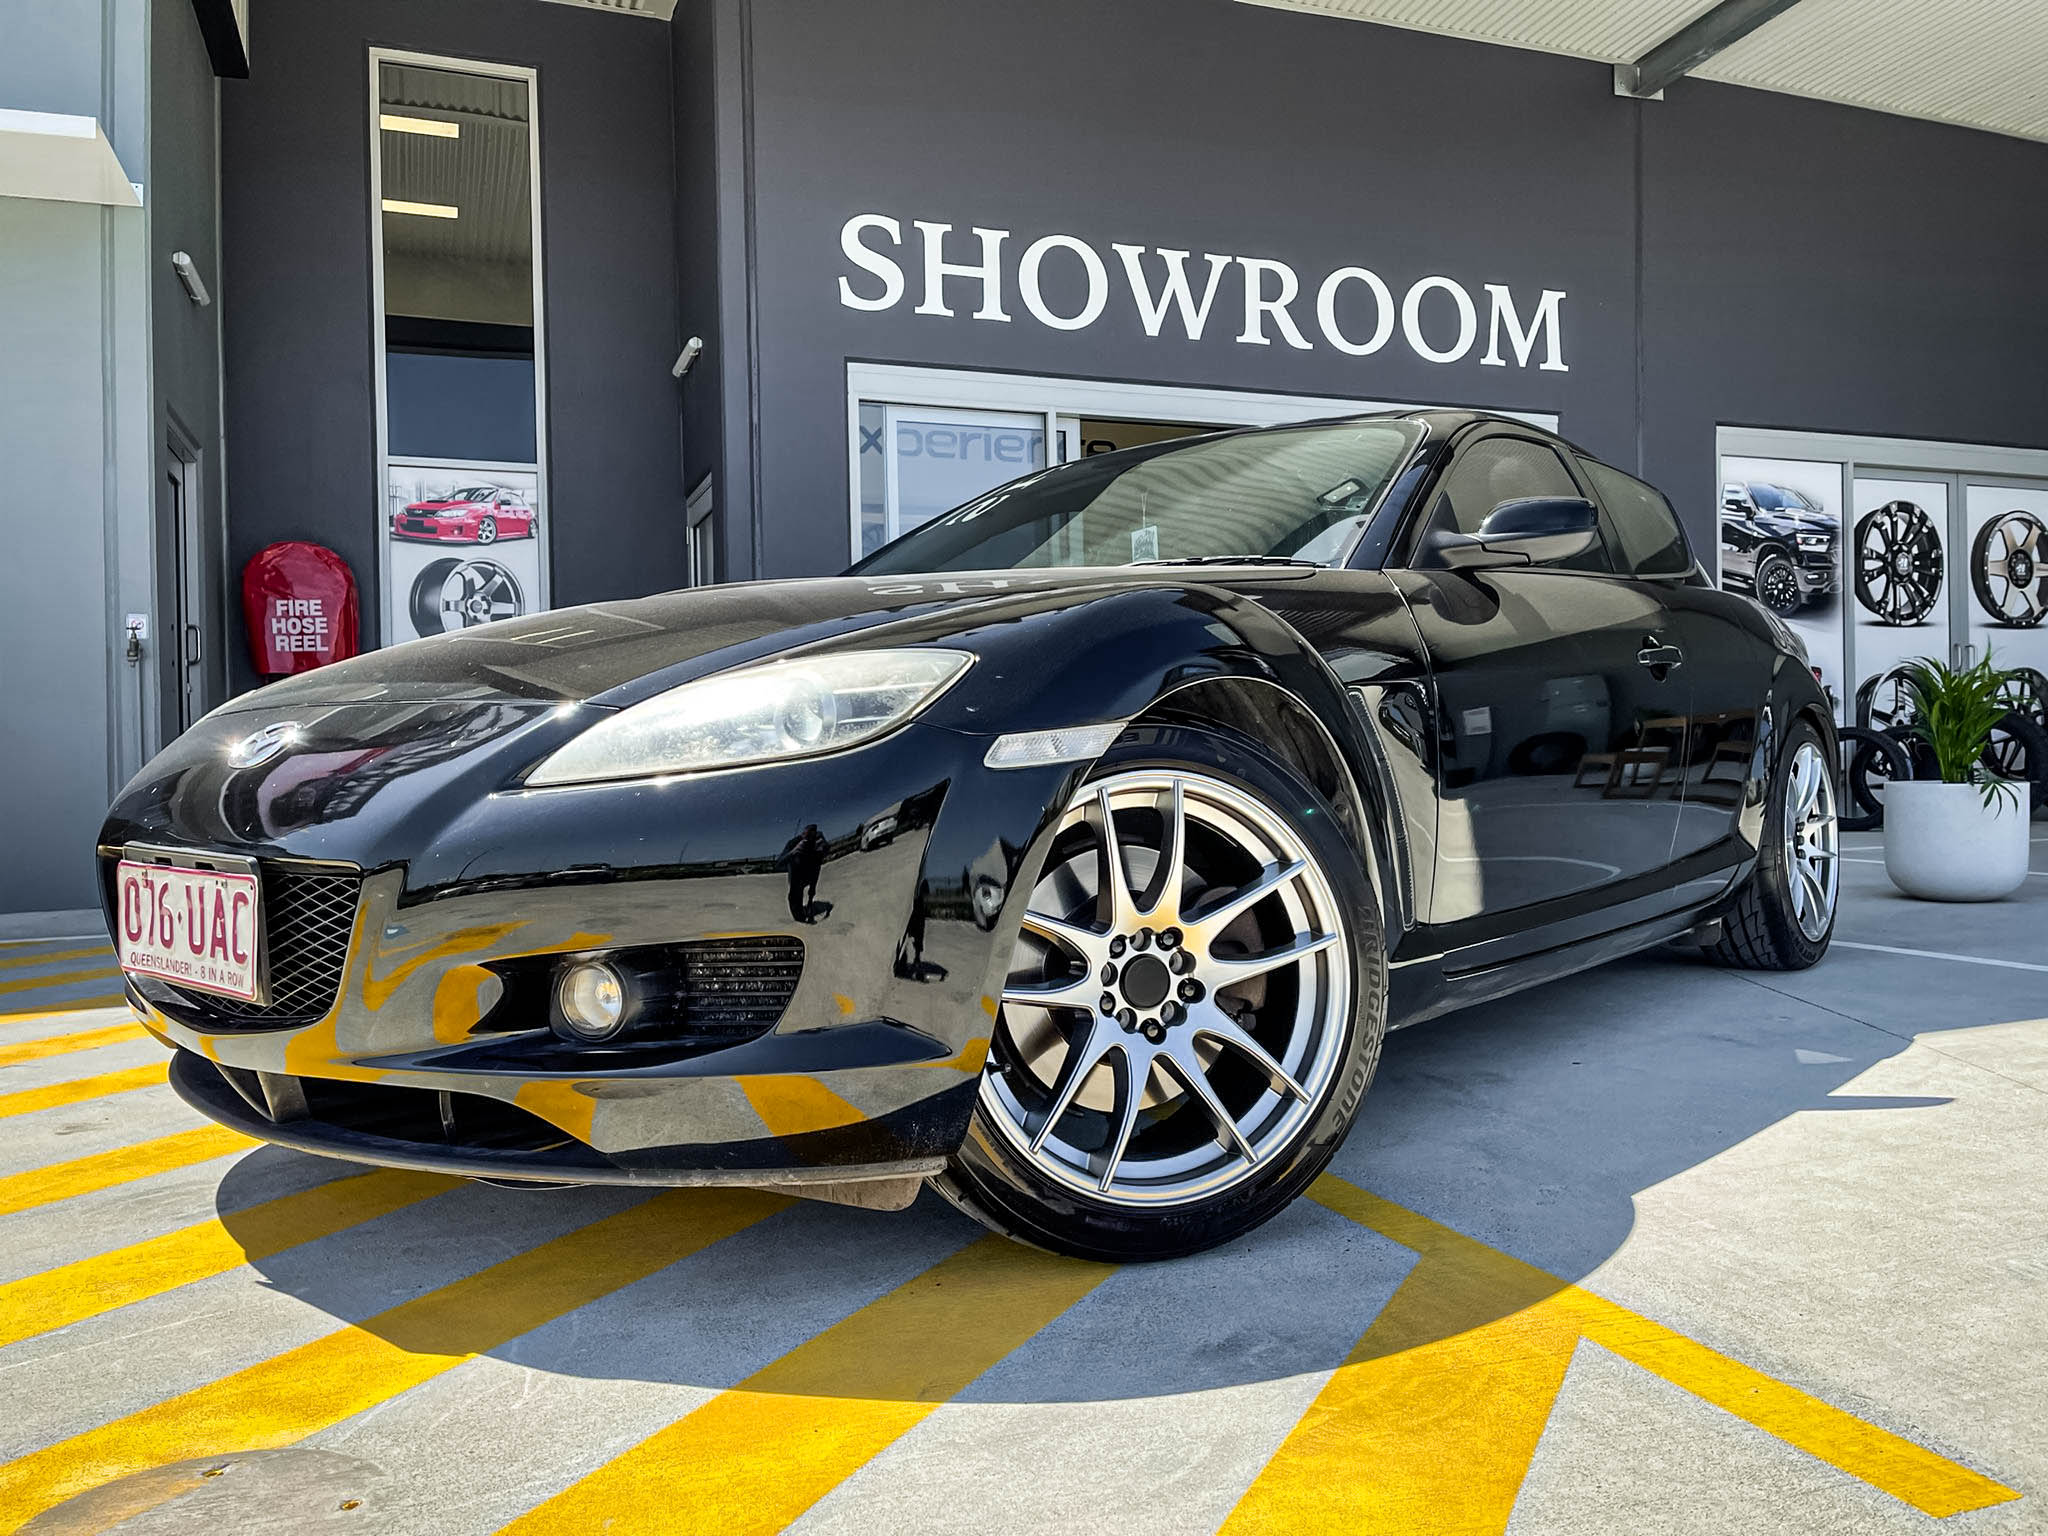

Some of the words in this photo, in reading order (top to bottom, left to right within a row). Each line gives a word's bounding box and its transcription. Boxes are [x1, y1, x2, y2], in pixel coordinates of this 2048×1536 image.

[837, 213, 1570, 373] SHOWROOM
[275, 599, 323, 616] FIRE
[271, 617, 329, 635] HOSE
[274, 634, 329, 652] REEL
[130, 951, 192, 977] QUEENSLANDER!
[200, 965, 206, 980] 8
[208, 967, 218, 982] IN
[219, 970, 225, 985] A
[227, 971, 244, 989] ROW
[1332, 905, 1384, 1134] BRIDGESTONE
